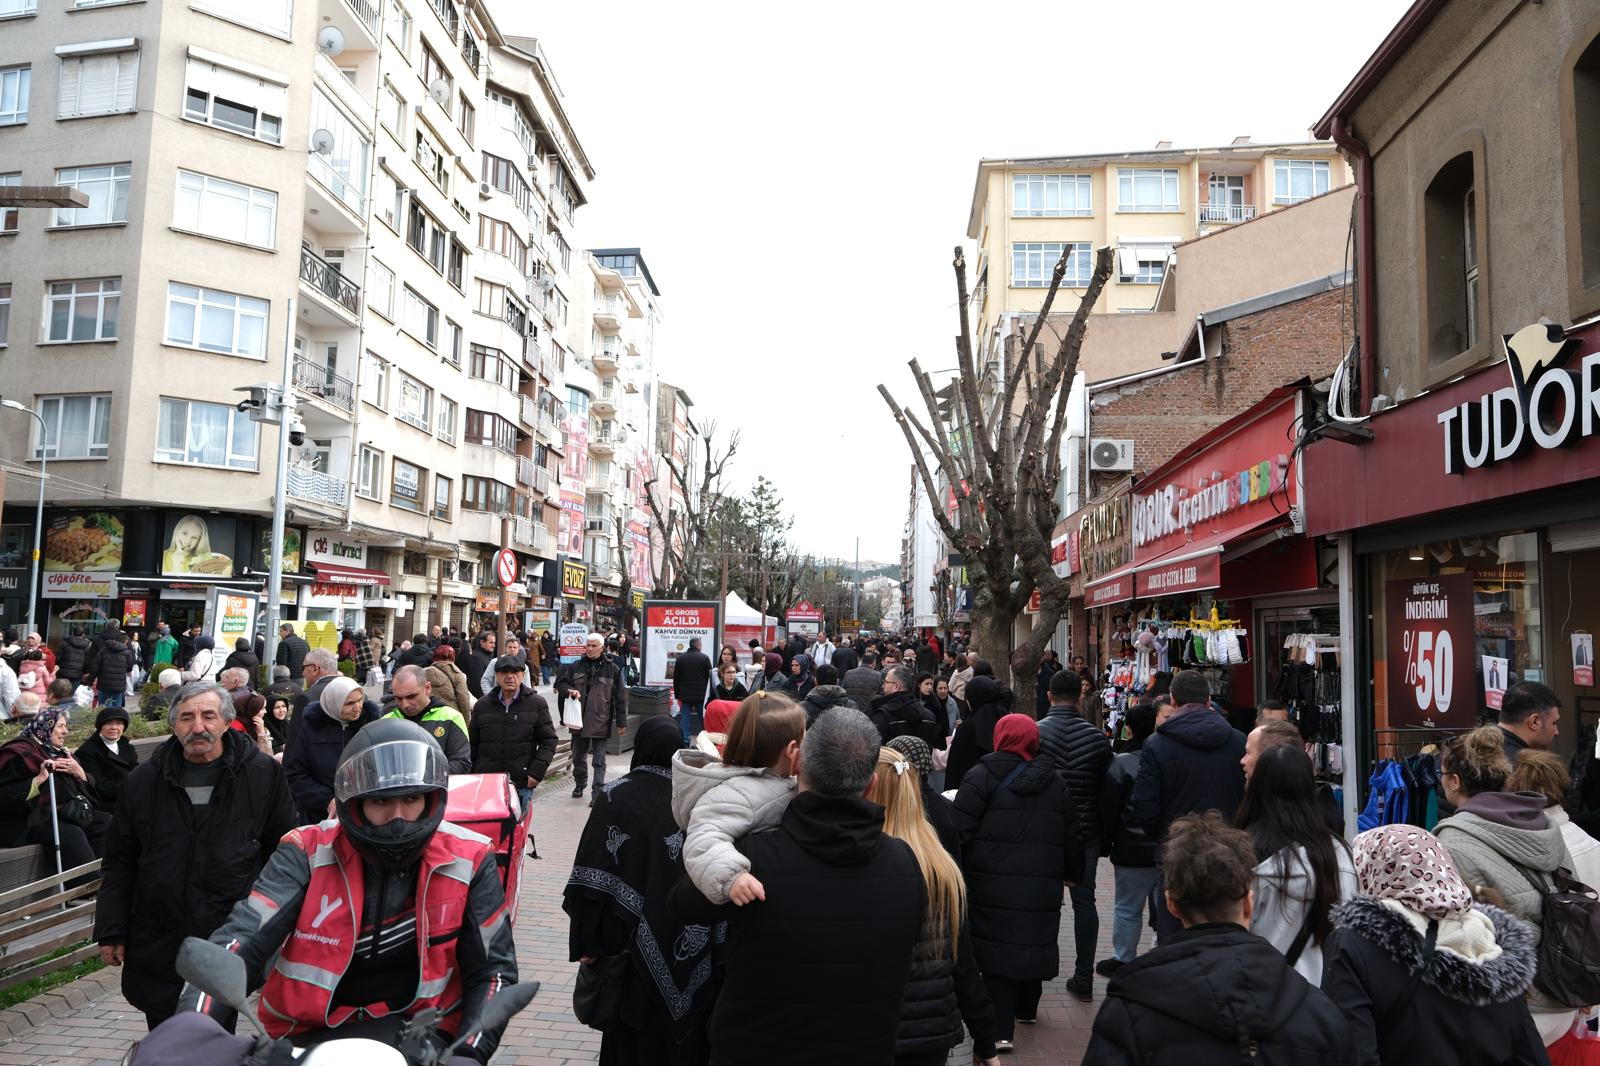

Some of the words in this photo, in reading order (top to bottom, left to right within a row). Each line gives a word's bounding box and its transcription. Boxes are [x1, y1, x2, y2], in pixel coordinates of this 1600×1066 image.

[1133, 485, 1176, 546] KORUR
[1191, 471, 1227, 523] GİYİM
[1240, 455, 1287, 503] BEBE
[313, 536, 327, 554] ÇİĞ
[332, 541, 362, 560] KÖFTECİ
[47, 574, 92, 585] çiğköfte
[1478, 570, 1497, 578] YENİ
[0, 577, 18, 589] HALI
[1413, 583, 1429, 595] BÜYÜK
[1430, 583, 1440, 595] KIŞ
[1406, 595, 1448, 620] İNDİRİMİ
[663, 616, 700, 626] AÇILDI
[1404, 629, 1454, 713] %50
[294, 928, 341, 947] Yemeksepeti
